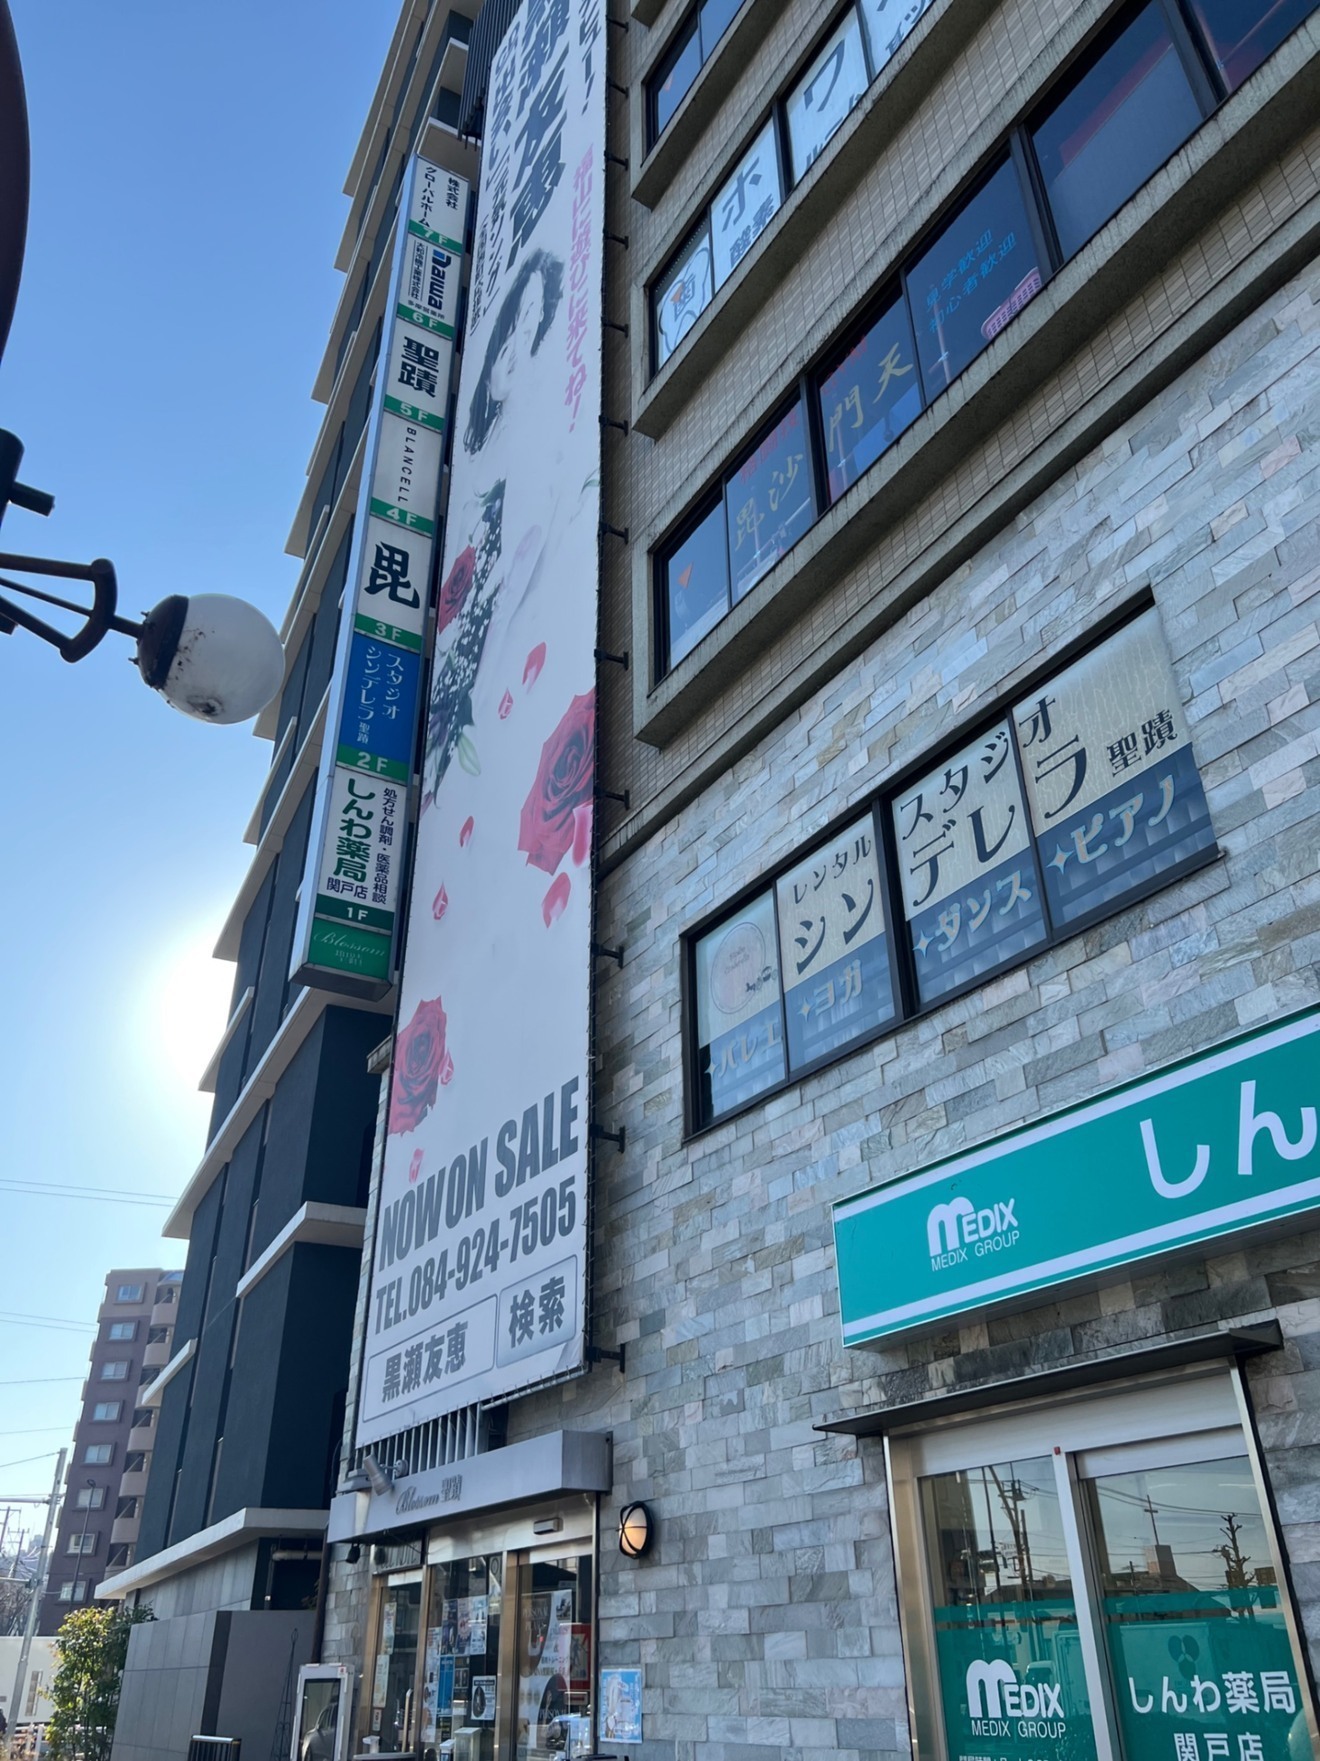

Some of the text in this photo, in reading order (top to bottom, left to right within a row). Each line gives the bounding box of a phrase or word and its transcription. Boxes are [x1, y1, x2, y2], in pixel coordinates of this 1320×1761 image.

[418, 166, 437, 228] グローバルホーム
[446, 177, 460, 210] 株式会社
[412, 311, 439, 330] 6F
[398, 336, 439, 399] 聖蹟
[400, 401, 429, 422] 5F
[398, 426, 417, 502] BLANCELL
[386, 508, 418, 526] 4F
[363, 541, 420, 610] 毘
[375, 622, 402, 641] 3F
[358, 646, 383, 720] シンデレラ
[382, 653, 405, 720] スタジオ
[356, 751, 388, 773] 2F
[332, 777, 376, 885] しんわ薬局
[792, 695, 1057, 905] レンタル スタジオ
[1070, 774, 1176, 866] ピアノ
[794, 708, 1178, 976] シンデレラ 聖蹟
[326, 876, 369, 901] 関戸店
[346, 906, 369, 921] 1F
[934, 869, 1032, 952] ダンス
[812, 958, 864, 1017] ヨガ
[1139, 1080, 1318, 1199] しん
[378, 1076, 580, 1273] NOW ON SALE
[930, 1230, 1020, 1272] MEDIX GROUP
[508, 1275, 566, 1349] 検索
[381, 1321, 469, 1403] 黒瀬友恵
[1128, 1671, 1297, 1716] しんわ薬局
[971, 1720, 1066, 1739] MEDIX GROUP
